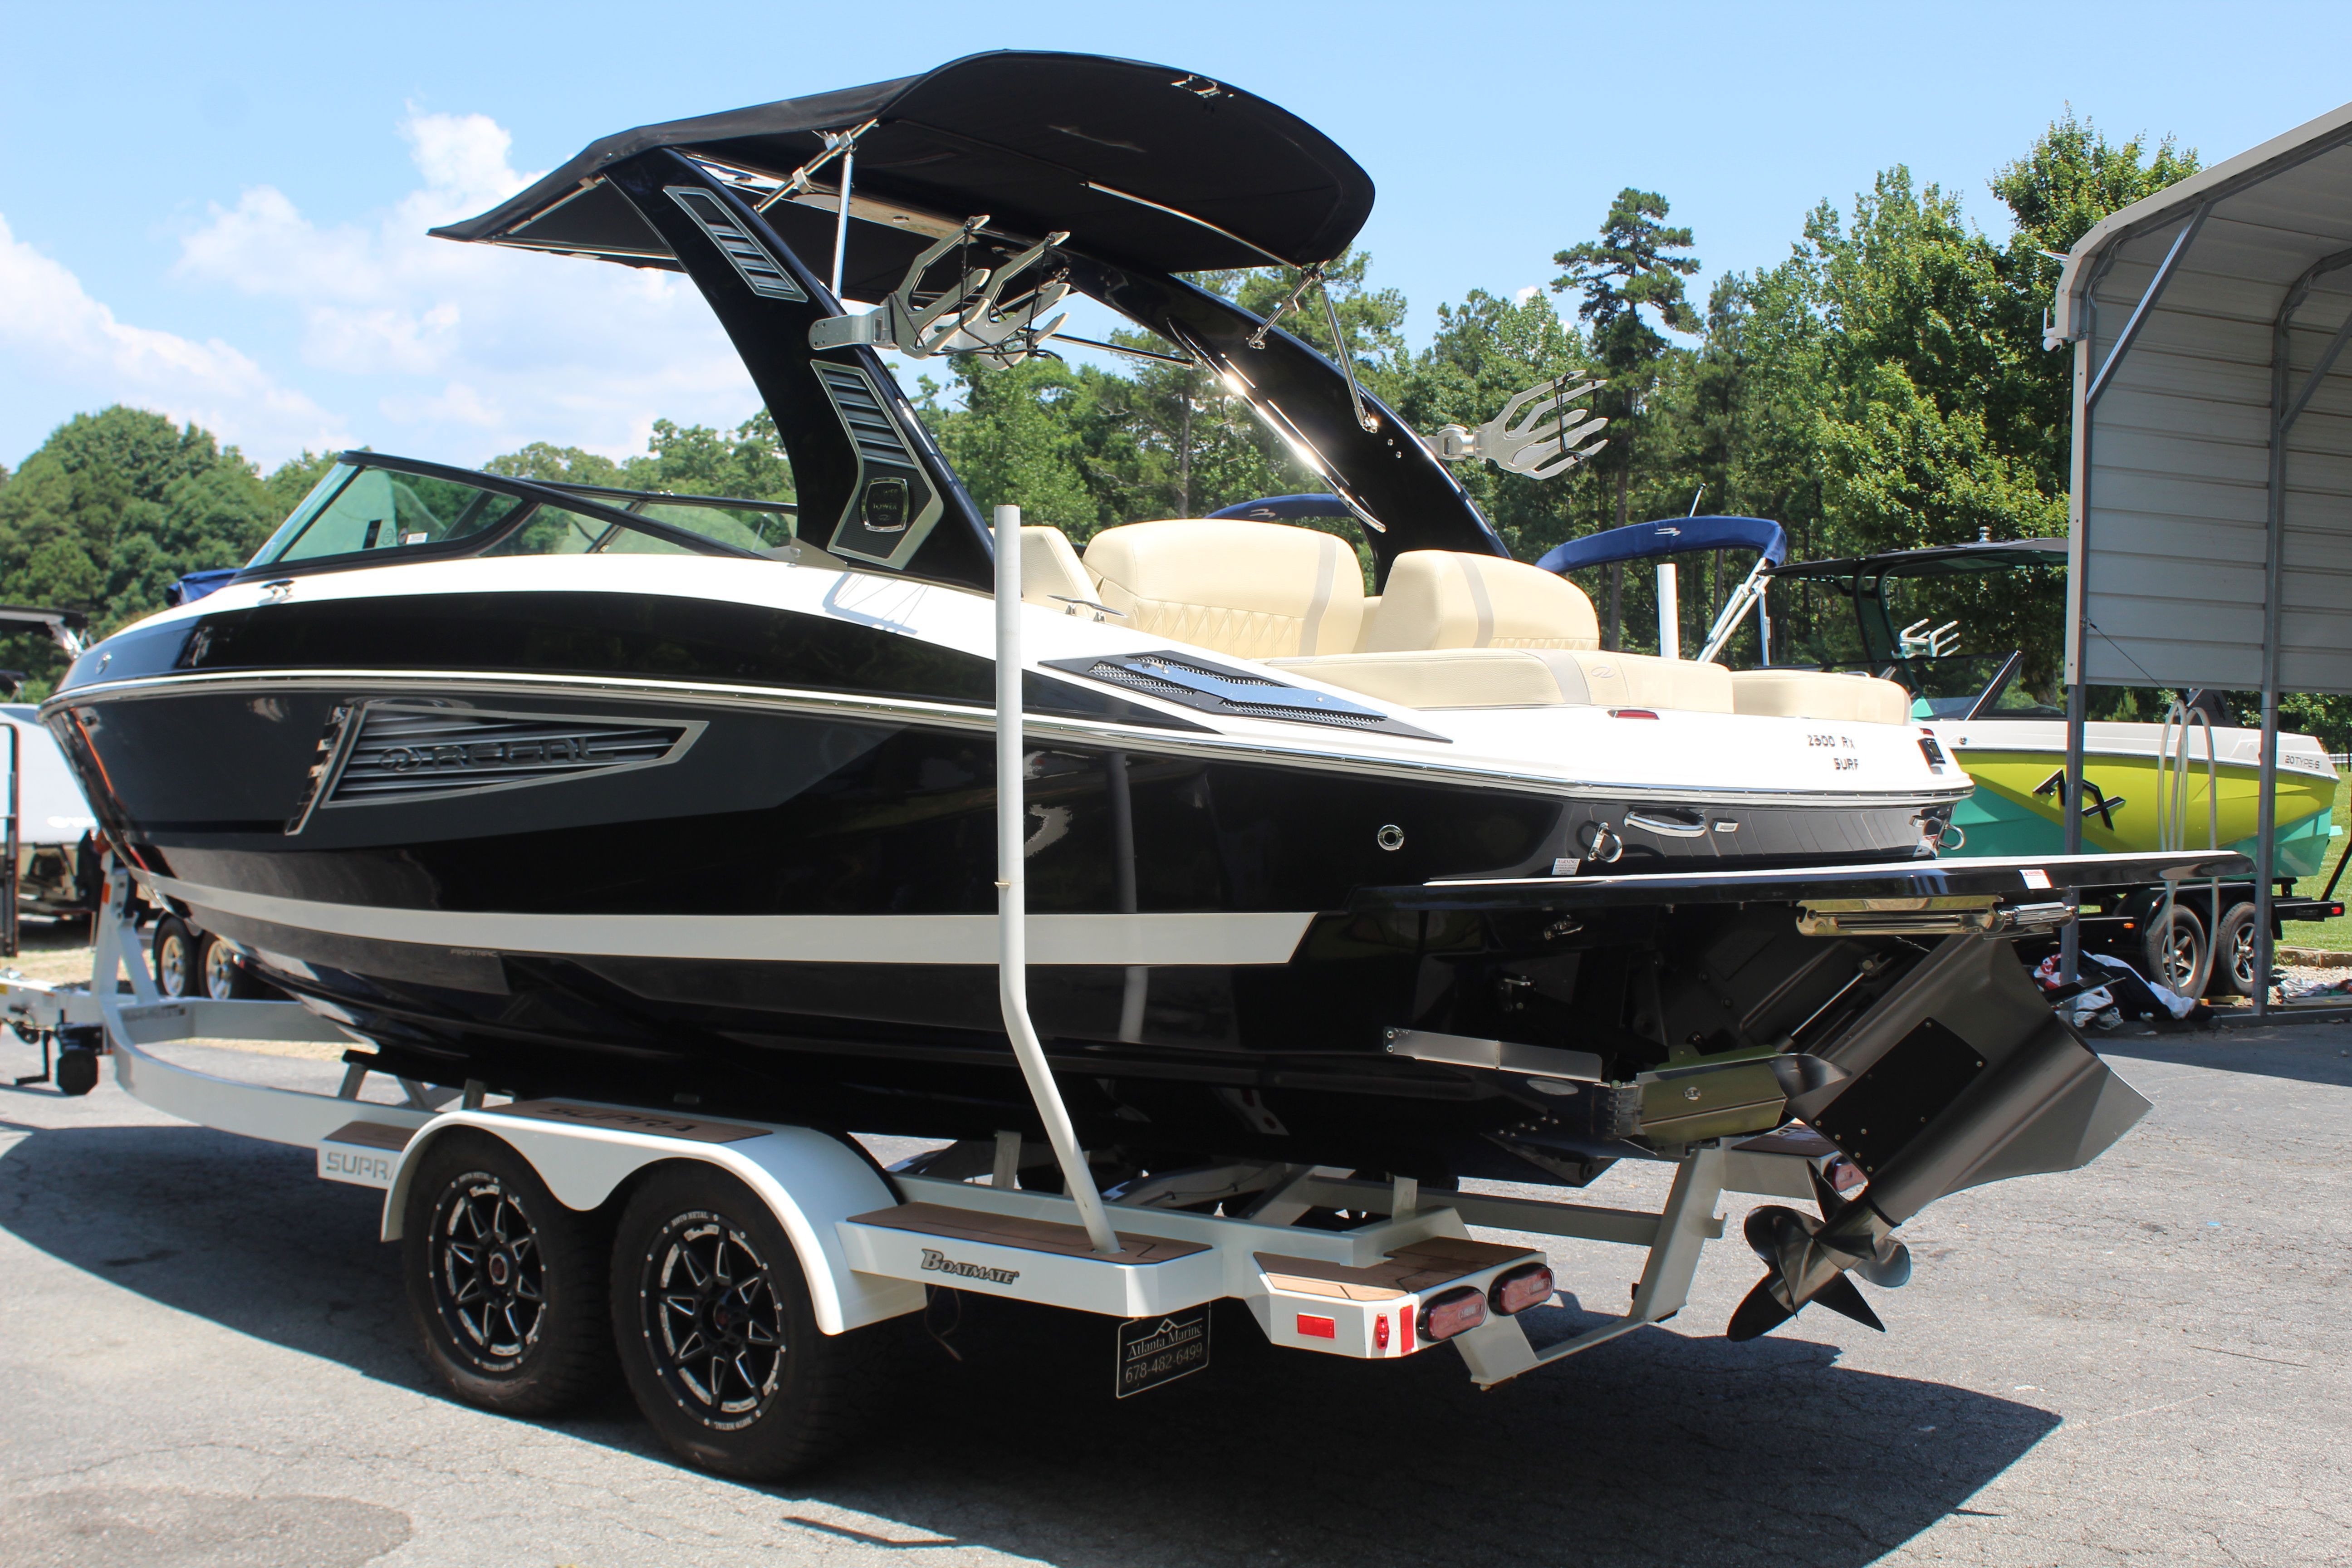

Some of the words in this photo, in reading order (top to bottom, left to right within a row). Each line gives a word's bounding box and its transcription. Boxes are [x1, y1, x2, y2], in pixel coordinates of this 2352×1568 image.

[432, 737, 614, 770] REGAL
[1841, 736, 1855, 750] RX
[1833, 758, 1859, 770] SURF
[671, 1213, 687, 1227] MOTO
[688, 1211, 709, 1220] METAL
[921, 1248, 1017, 1284] BOATMATE
[1128, 1337, 1165, 1358] Atlanta
[1169, 1324, 1202, 1343] Marine
[1126, 1342, 1202, 1383] 678-482-6499
